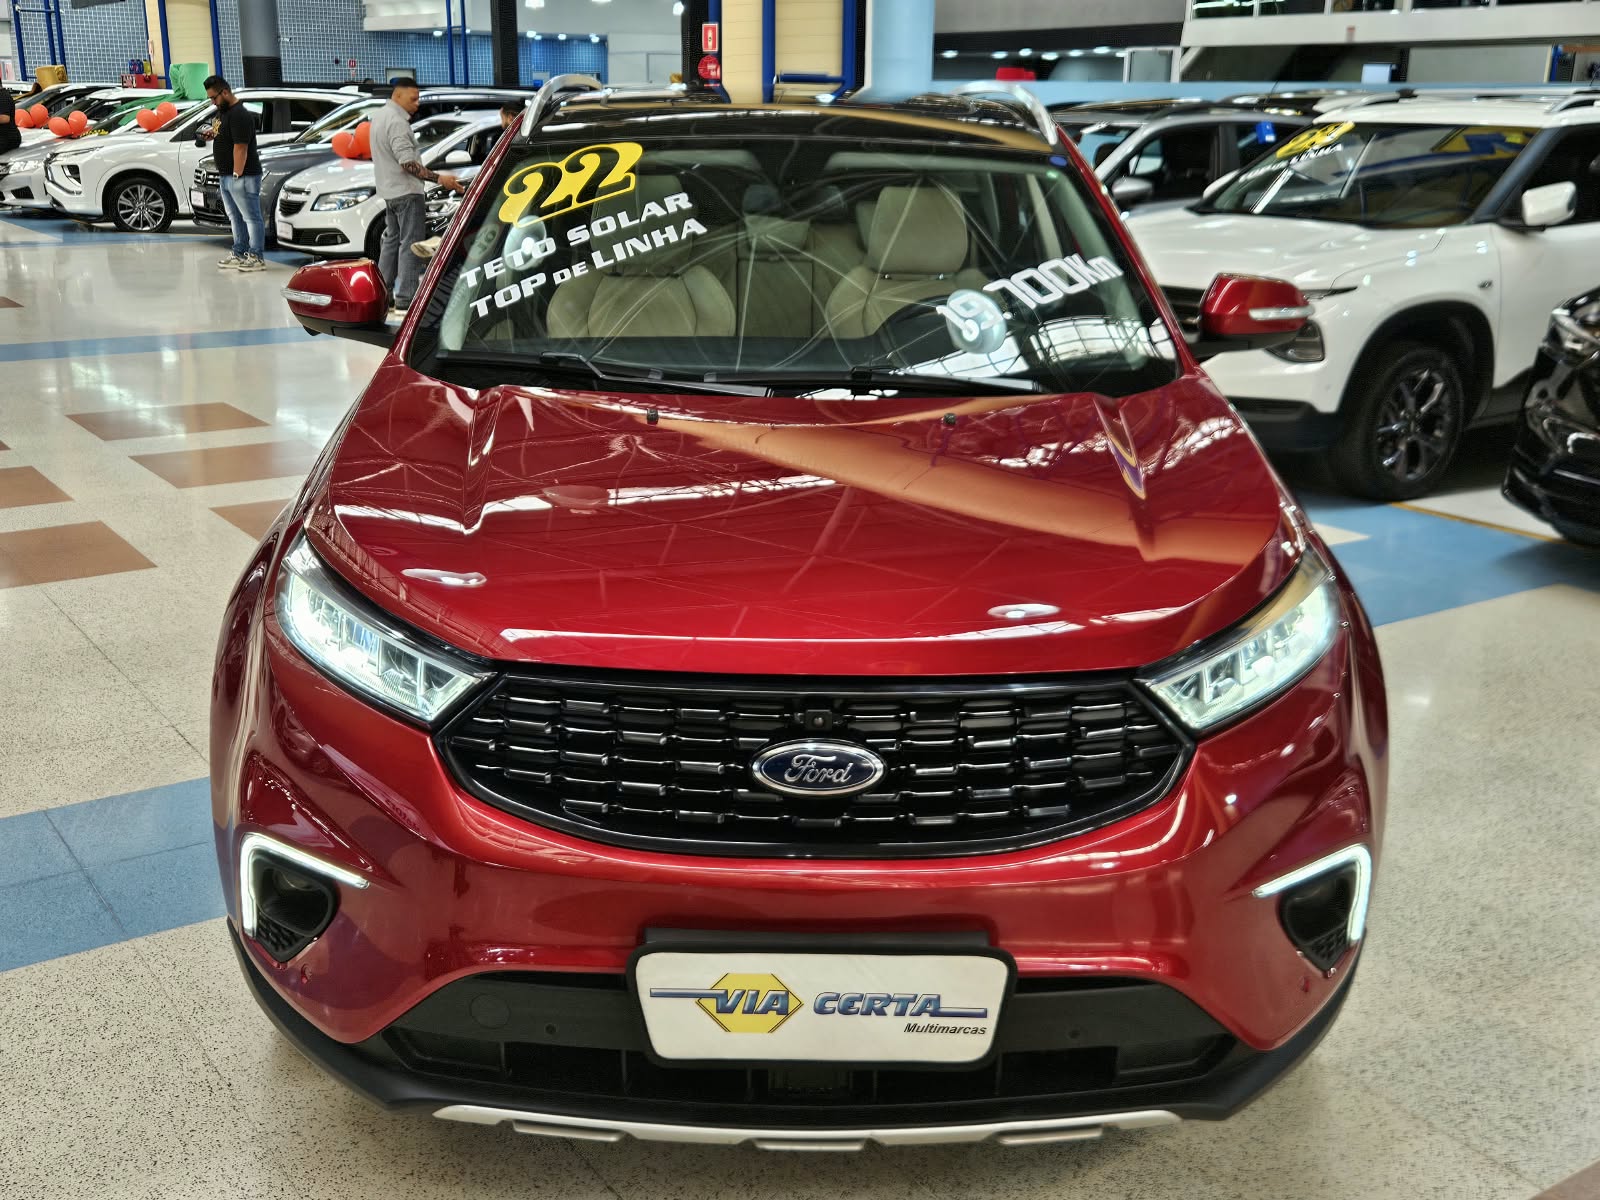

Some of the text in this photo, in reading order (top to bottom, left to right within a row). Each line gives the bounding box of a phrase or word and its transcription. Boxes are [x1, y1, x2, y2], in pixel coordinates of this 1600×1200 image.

[499, 142, 643, 228] 22
[459, 236, 557, 289] TETO
[566, 191, 694, 247] SOLAR
[469, 271, 547, 318] TOP
[552, 260, 589, 286] DE
[591, 217, 708, 270] LINHA
[783, 753, 854, 783] Ford
[714, 988, 942, 1017] VIA CERTA
[903, 1022, 987, 1036] Multimarcas
